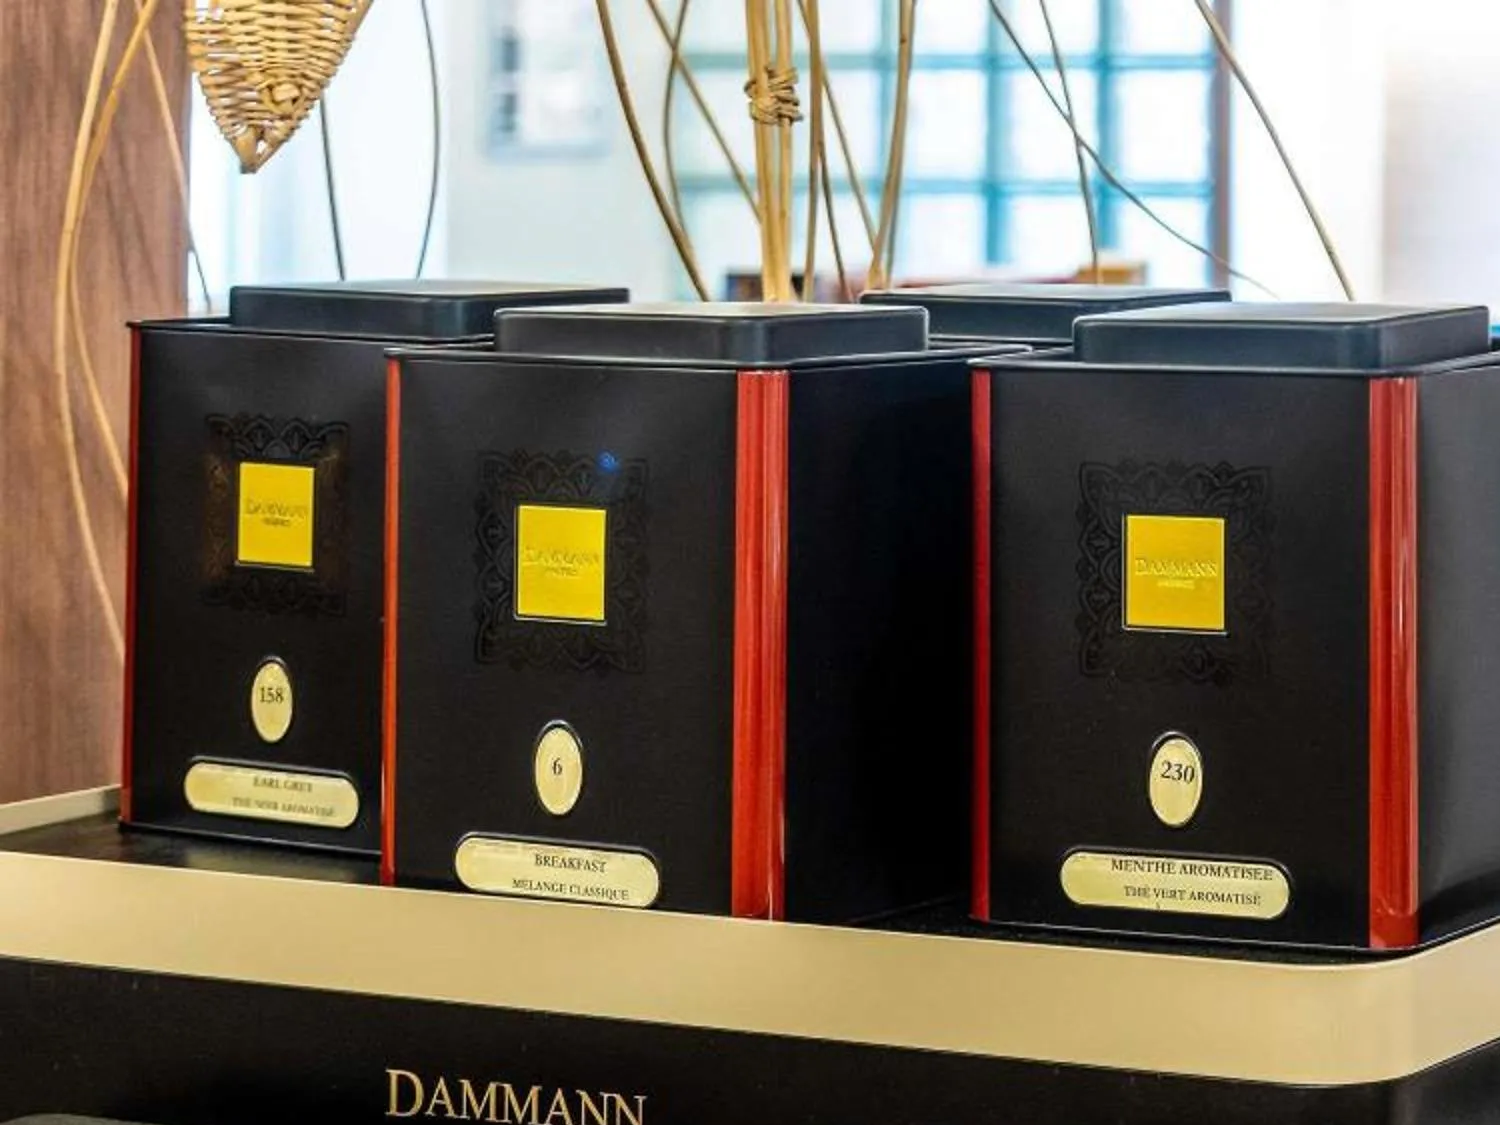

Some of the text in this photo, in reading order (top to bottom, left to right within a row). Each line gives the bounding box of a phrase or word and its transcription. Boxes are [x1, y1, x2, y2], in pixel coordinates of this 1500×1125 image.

[259, 686, 284, 704] 158
[552, 756, 563, 776] 6
[1160, 759, 1195, 785] 230
[252, 776, 280, 790] EARL
[534, 853, 608, 874] BREAKFAST
[1110, 858, 1176, 876] MENTHE
[569, 883, 630, 901] CLASSIQUE
[1153, 887, 1187, 901] VERT
